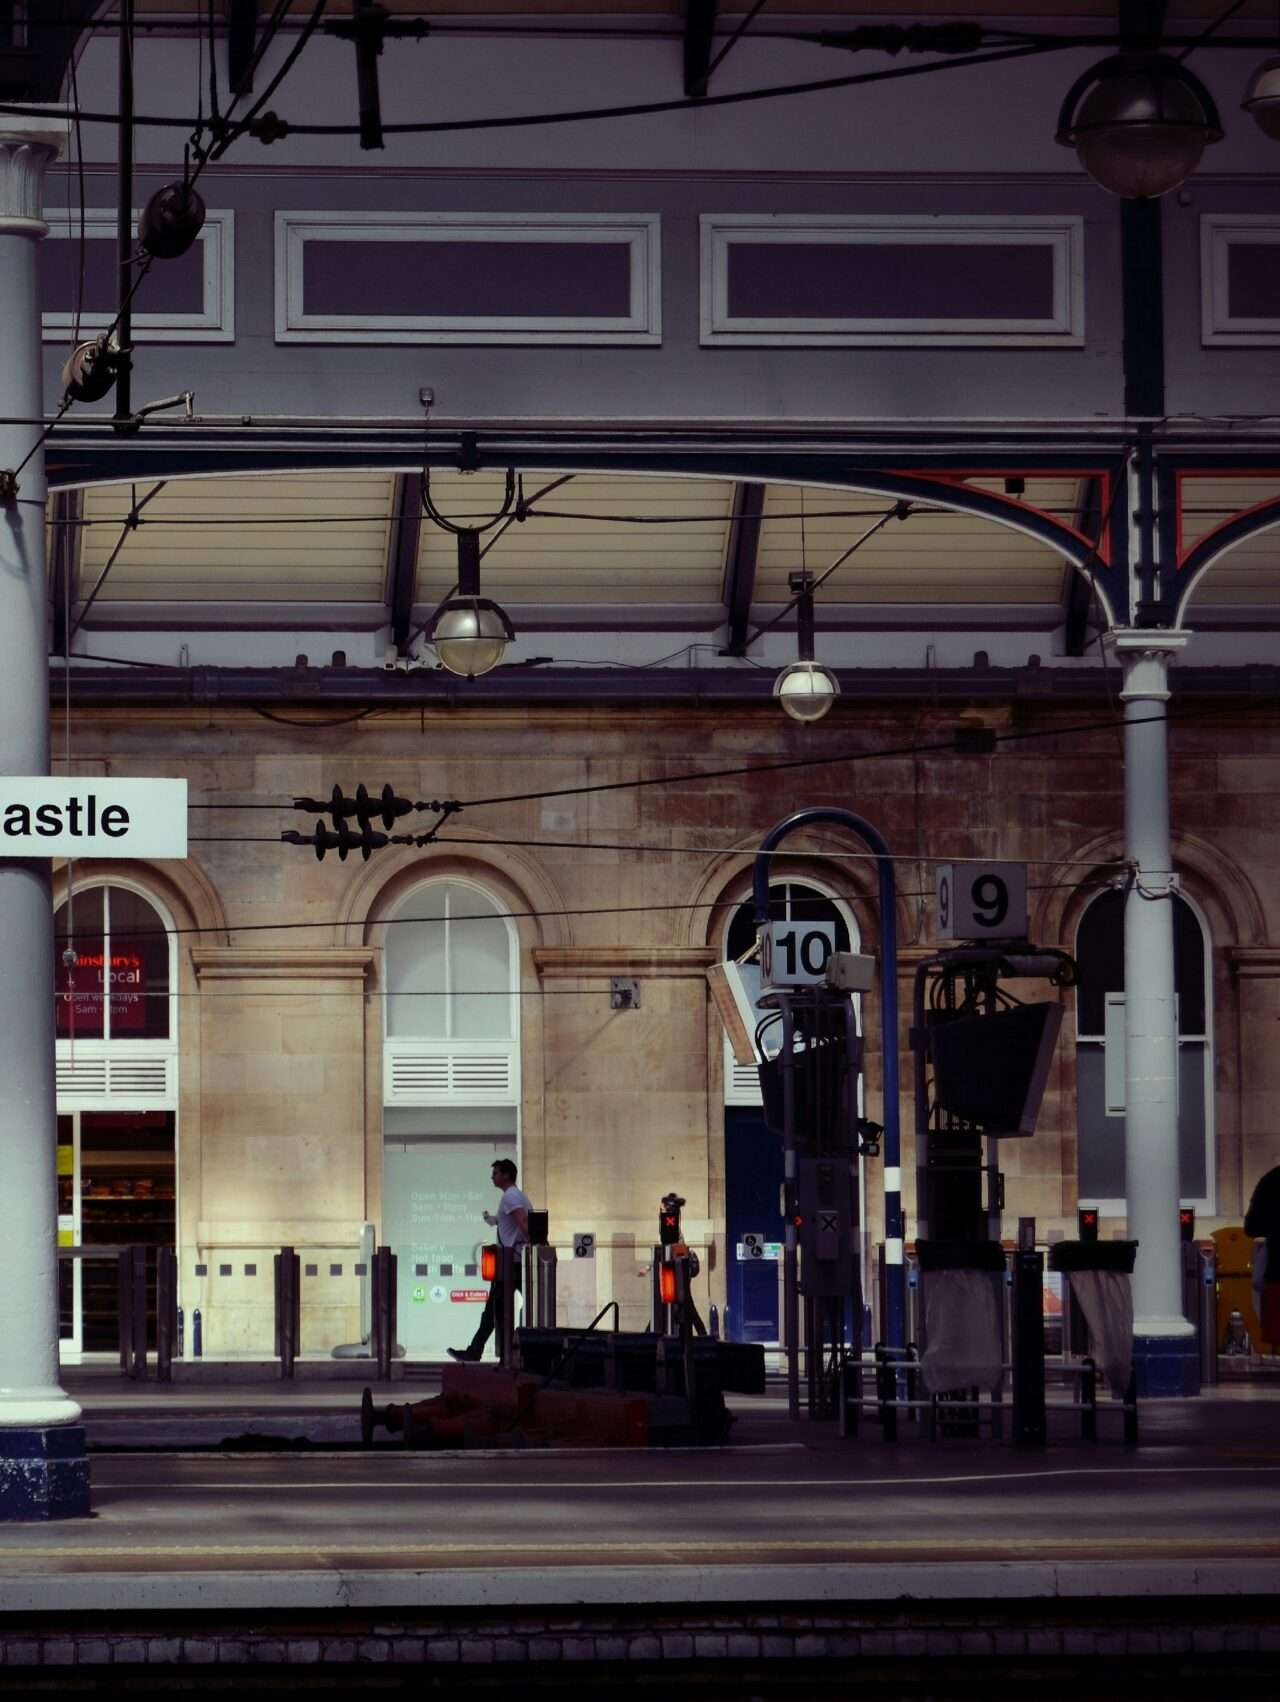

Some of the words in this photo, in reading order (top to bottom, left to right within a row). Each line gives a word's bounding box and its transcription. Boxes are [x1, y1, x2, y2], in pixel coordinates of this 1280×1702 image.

[939, 877, 949, 929] 9
[970, 874, 1009, 928] 9
[97, 968, 141, 984] Local
[775, 930, 832, 976] 10
